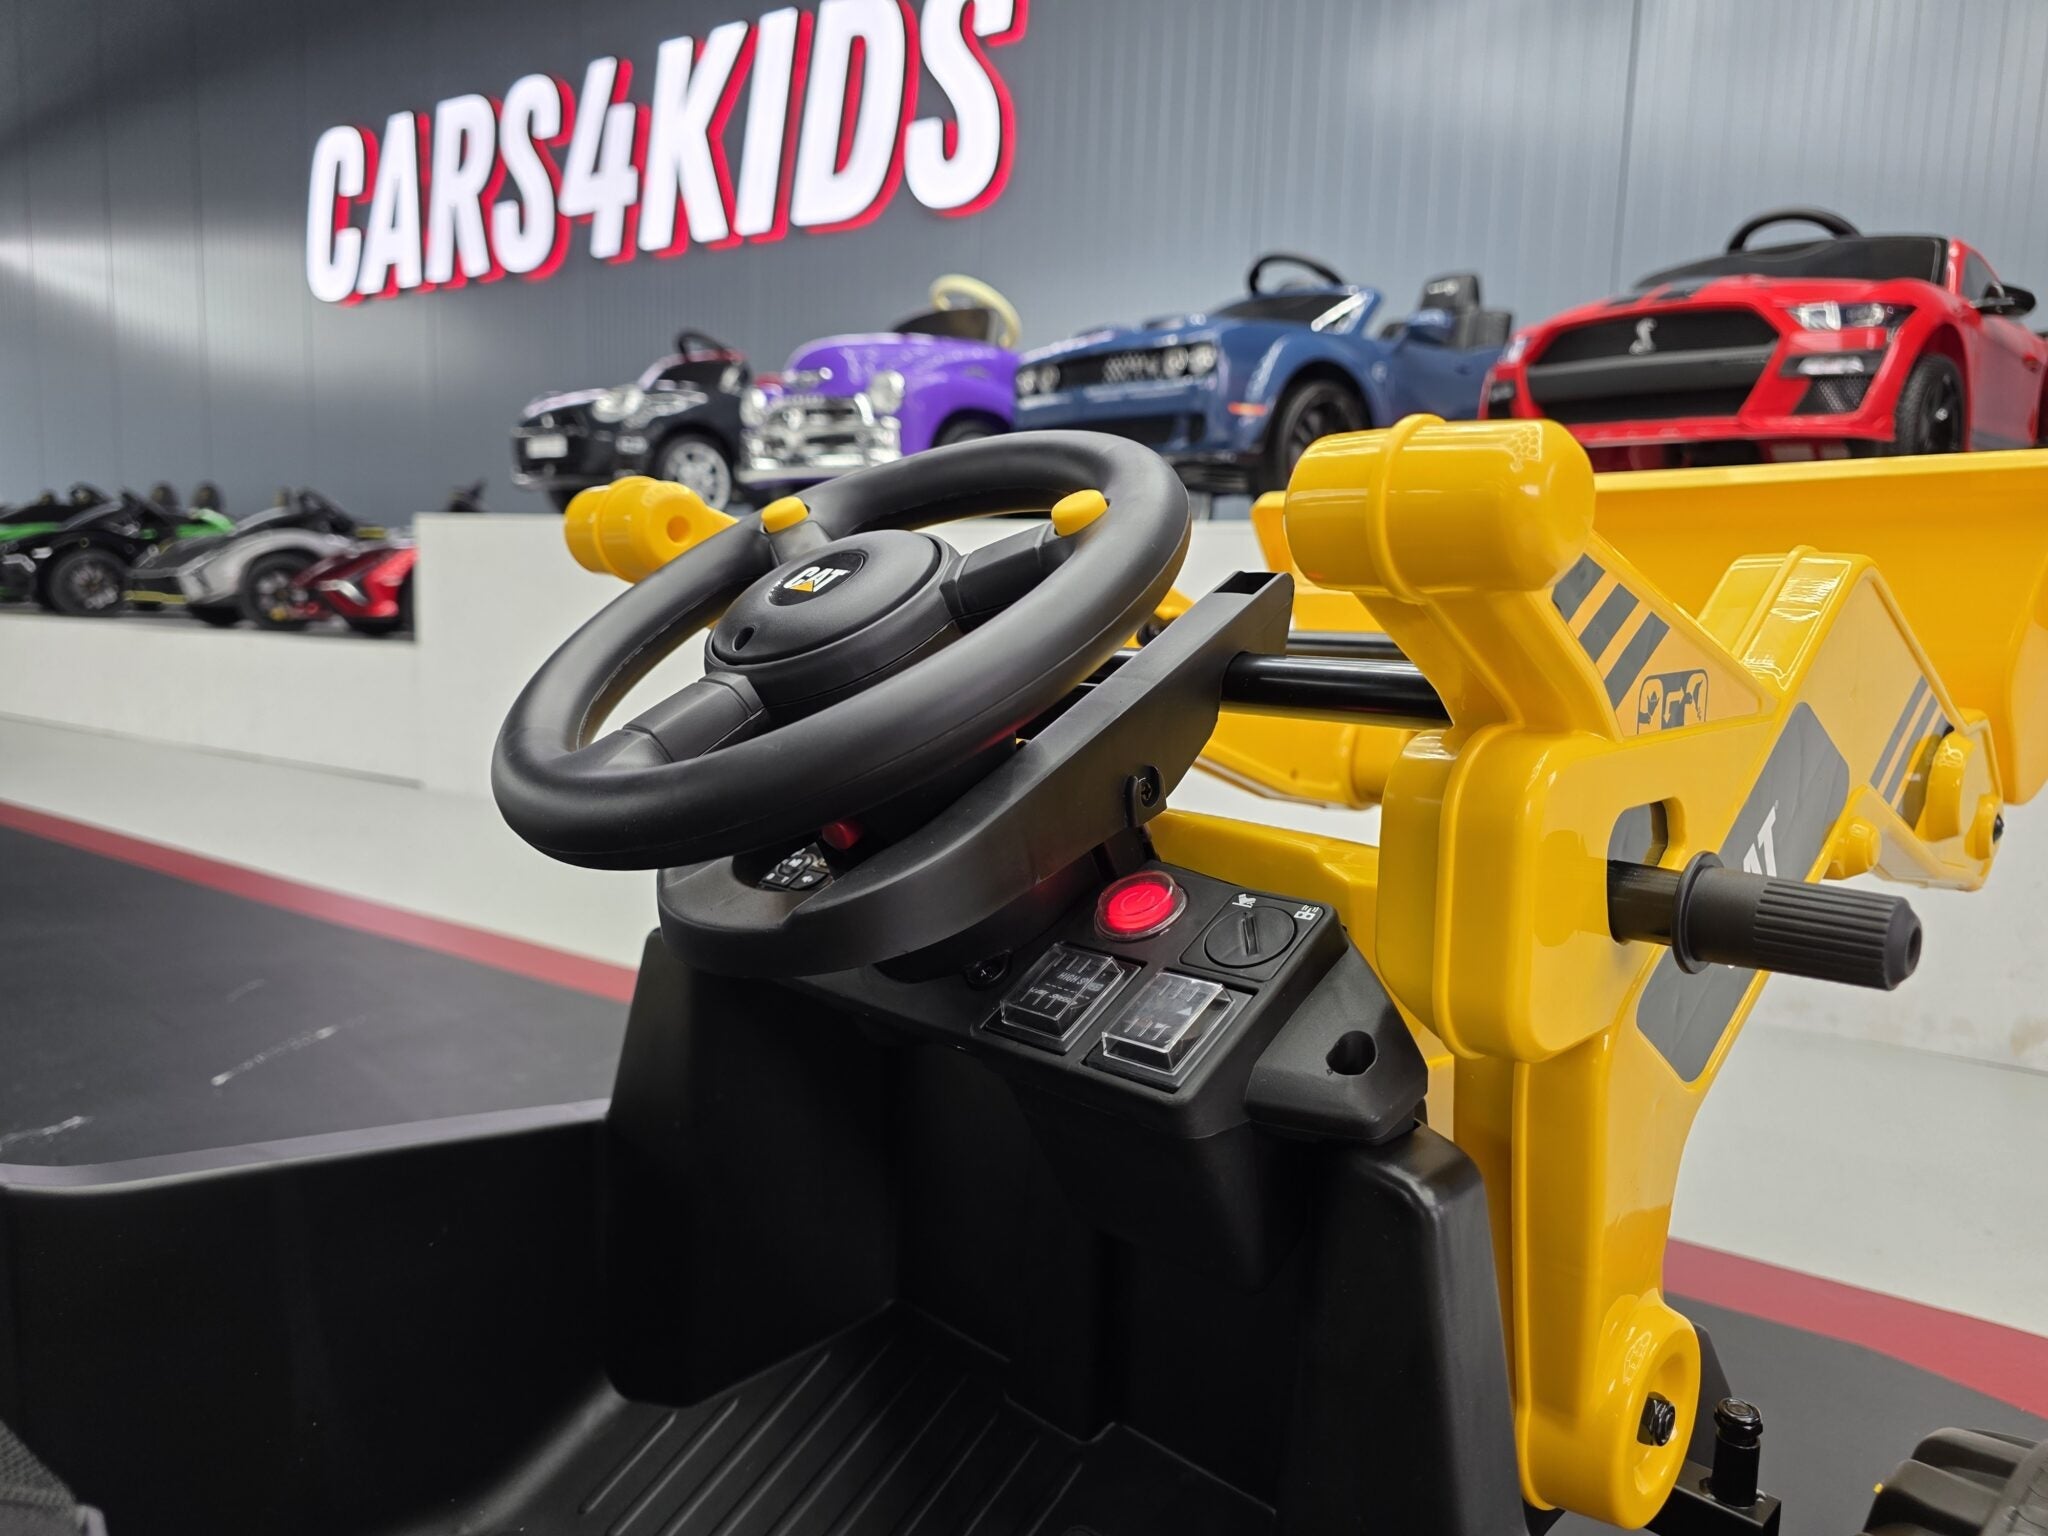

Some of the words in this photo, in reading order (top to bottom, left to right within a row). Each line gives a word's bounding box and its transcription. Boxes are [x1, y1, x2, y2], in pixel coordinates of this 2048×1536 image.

[306, 0, 1027, 306] CARS4KIDS
[783, 566, 850, 592] CAT
[1056, 972, 1080, 983] HIGH
